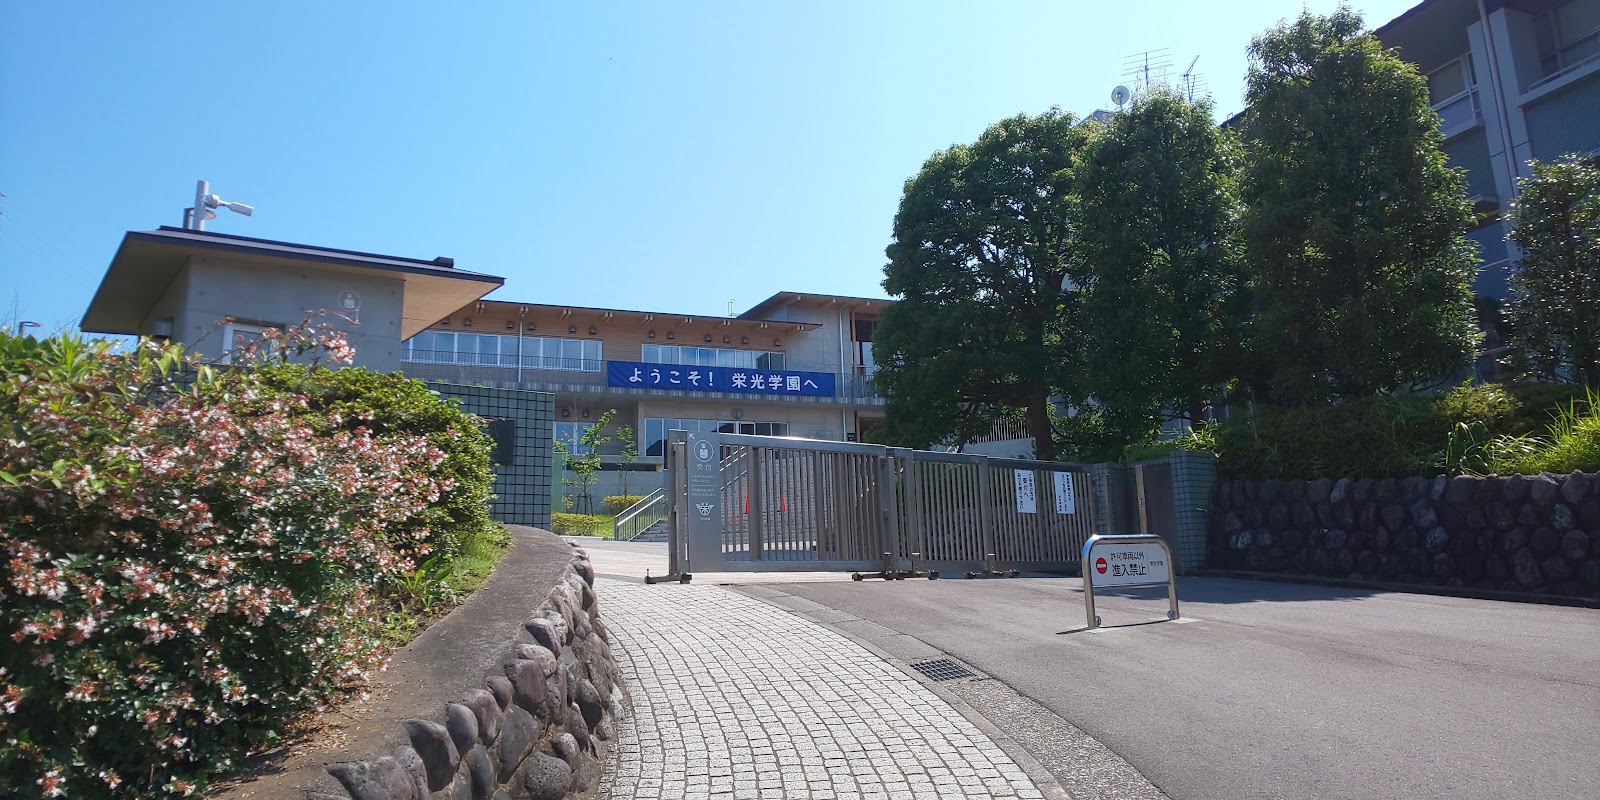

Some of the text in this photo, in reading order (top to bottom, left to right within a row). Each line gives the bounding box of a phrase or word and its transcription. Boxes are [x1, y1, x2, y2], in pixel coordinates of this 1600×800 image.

[629, 368, 818, 392] ようこそ！ 栄光学園へ
[1110, 552, 1144, 561] 許可車両以外
[1112, 563, 1147, 576] 進入禁止
